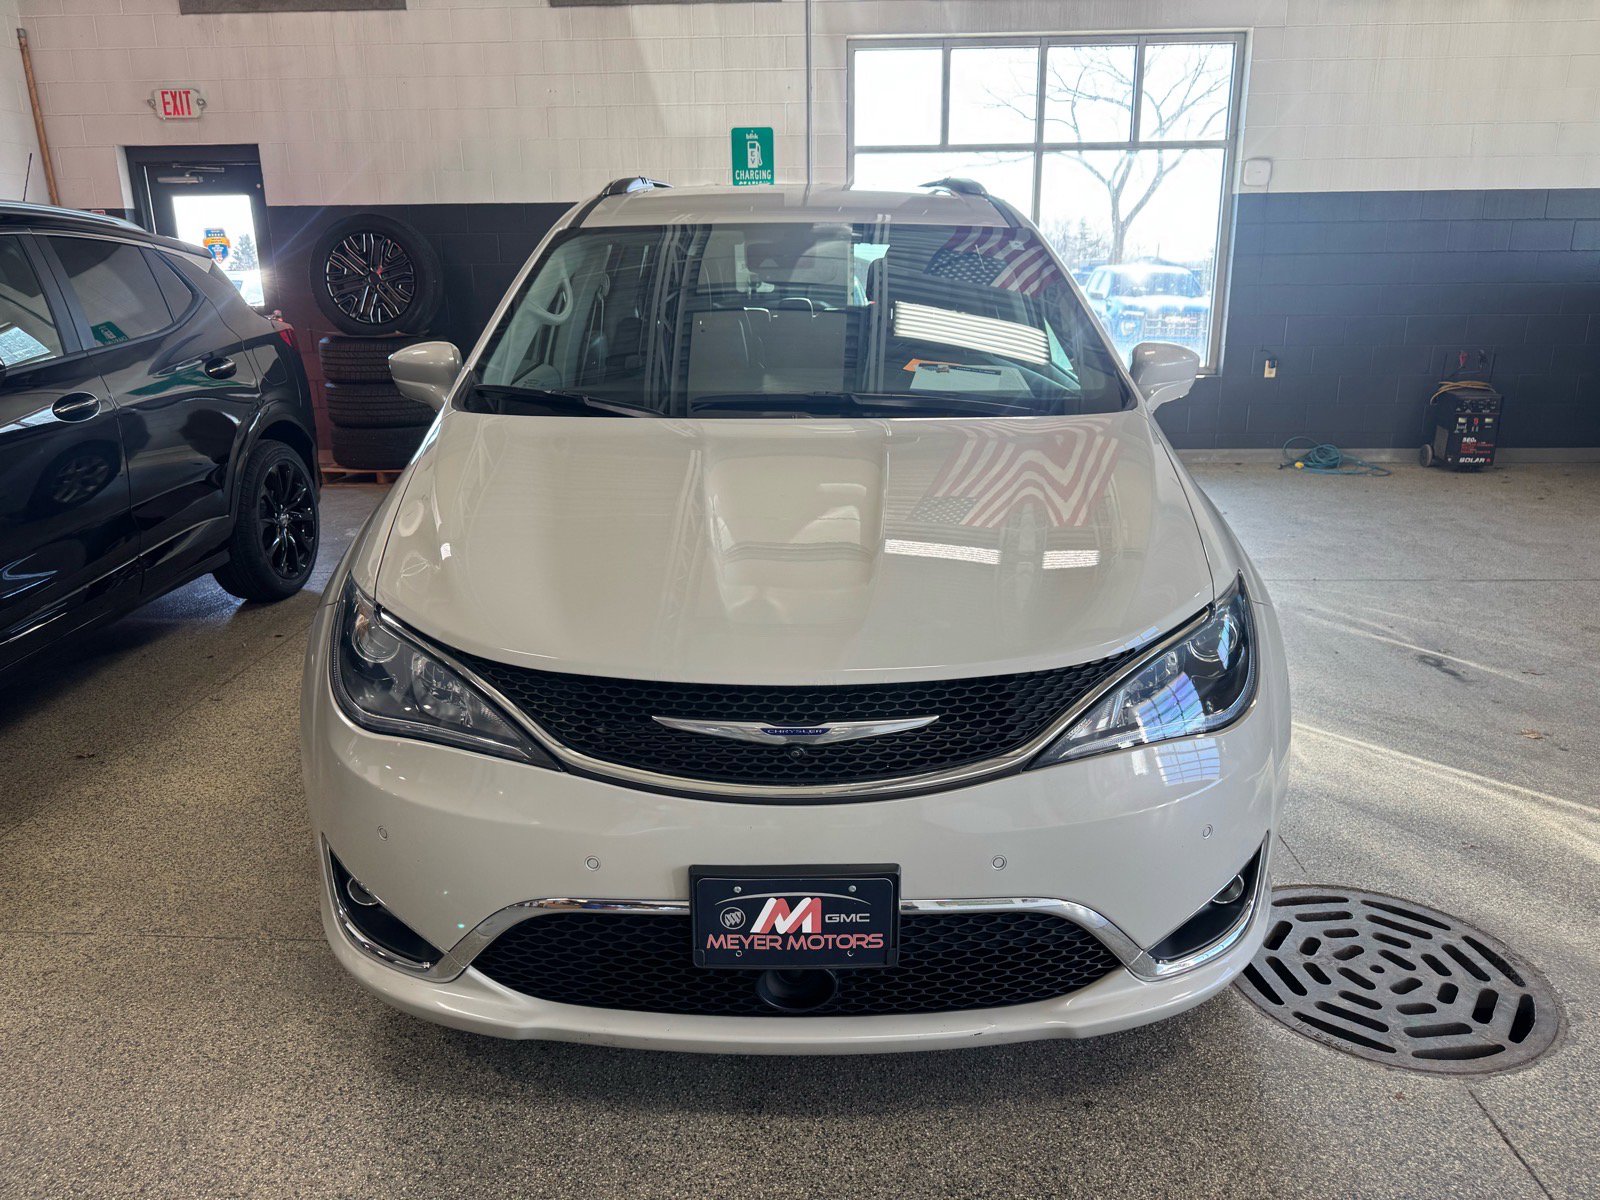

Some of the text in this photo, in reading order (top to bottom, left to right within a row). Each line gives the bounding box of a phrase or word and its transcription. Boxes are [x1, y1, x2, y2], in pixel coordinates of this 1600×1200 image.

[161, 90, 192, 116] EXIT
[735, 169, 772, 181] CHARGING
[825, 913, 871, 924] GMC
[706, 933, 885, 951] MEYER MOTORS
